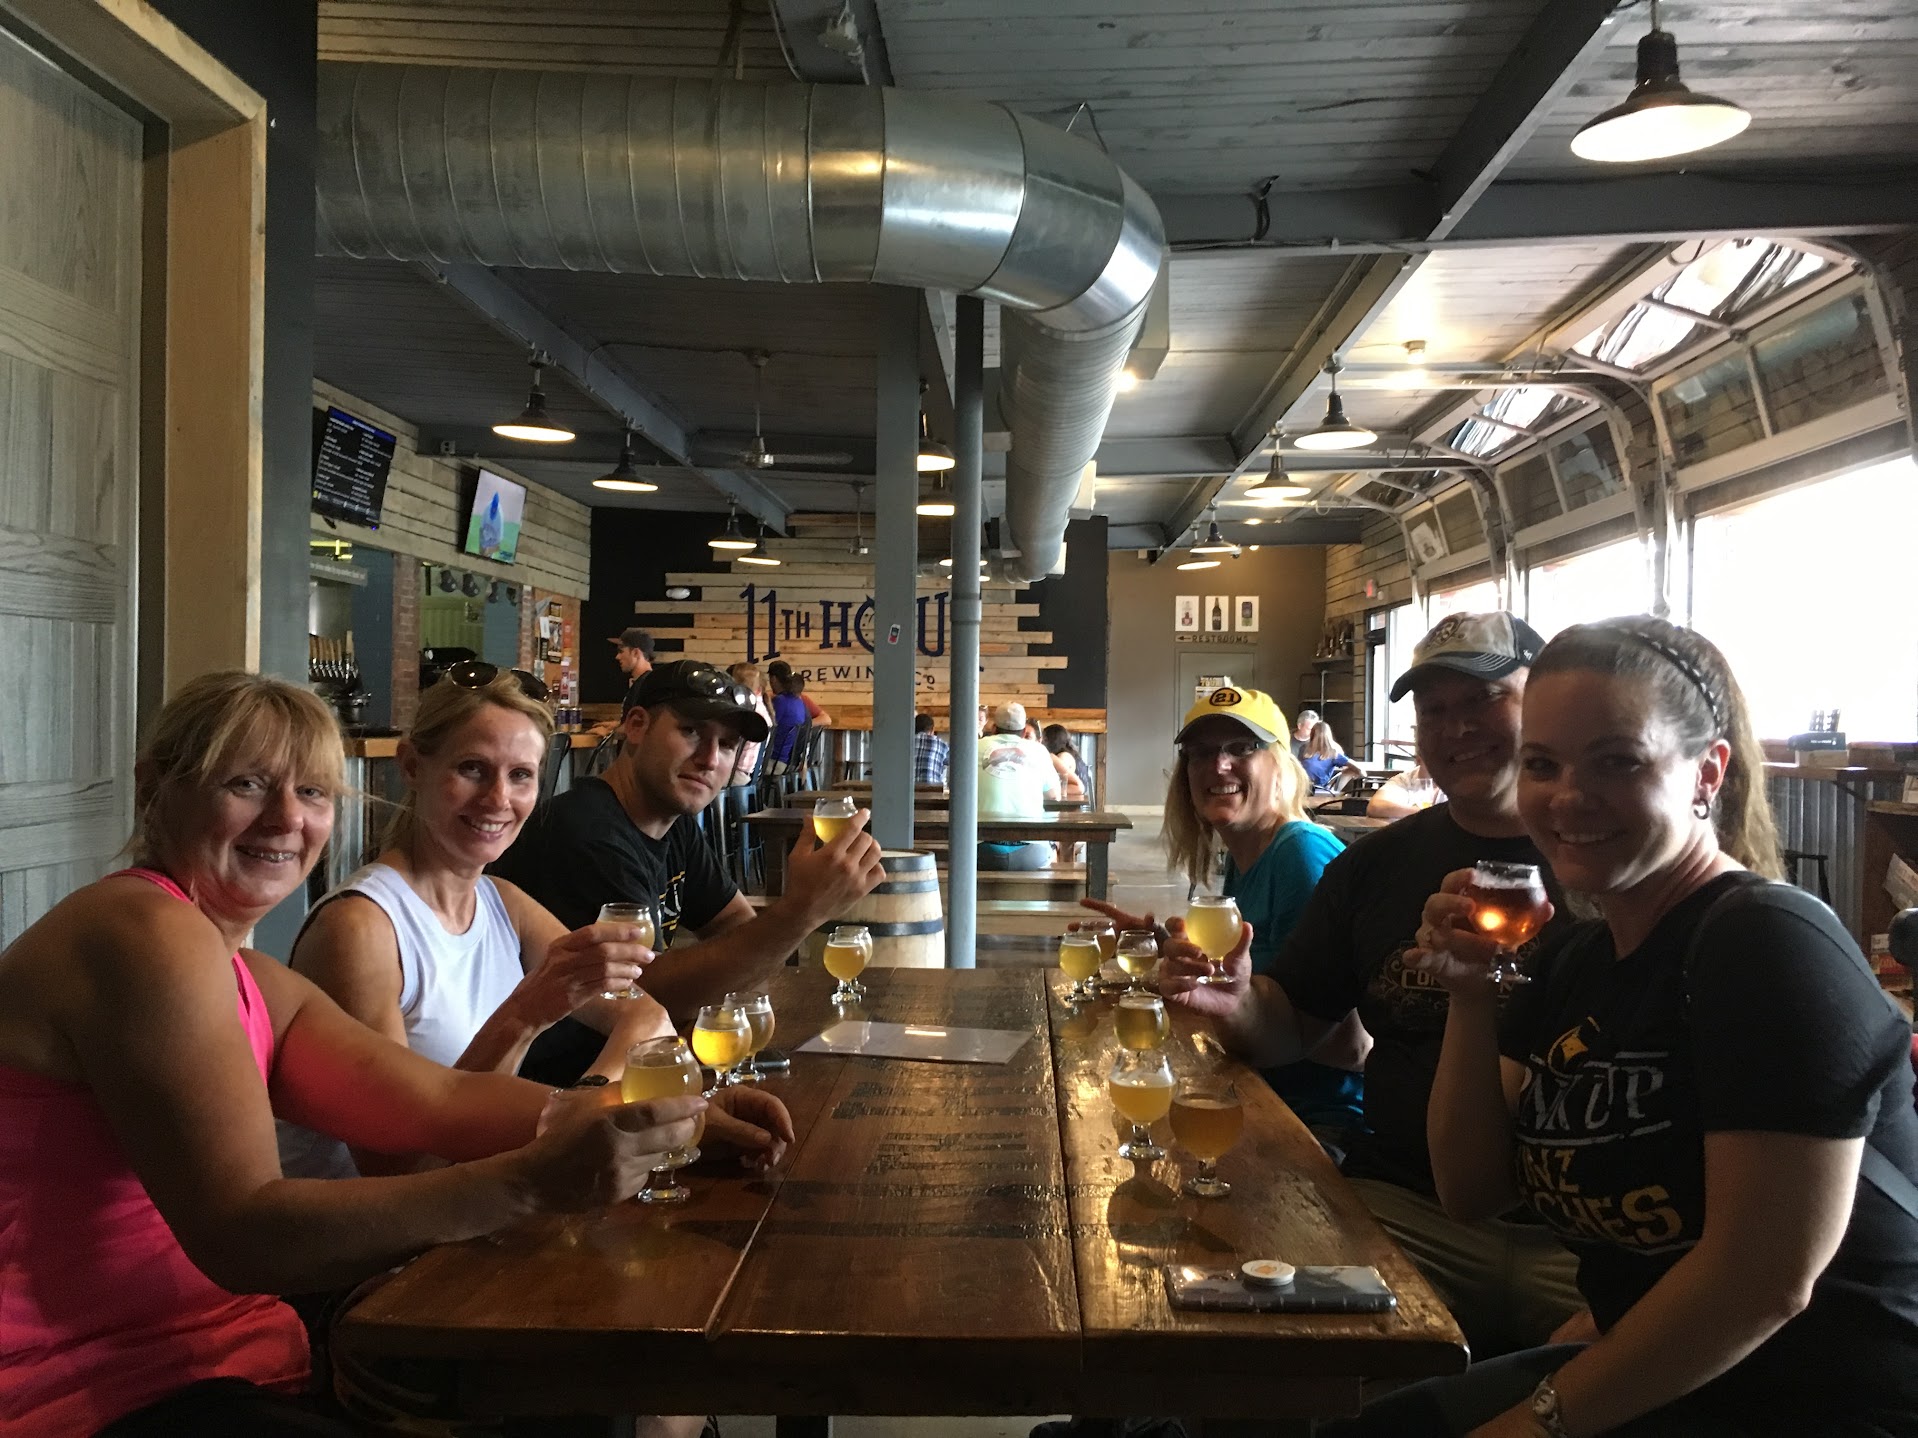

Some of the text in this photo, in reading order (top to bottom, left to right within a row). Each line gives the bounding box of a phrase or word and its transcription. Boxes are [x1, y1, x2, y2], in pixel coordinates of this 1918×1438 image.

[1192, 634, 1249, 645] RESTROOMS
[801, 665, 875, 683] REWIN
[1214, 692, 1235, 703] 21
